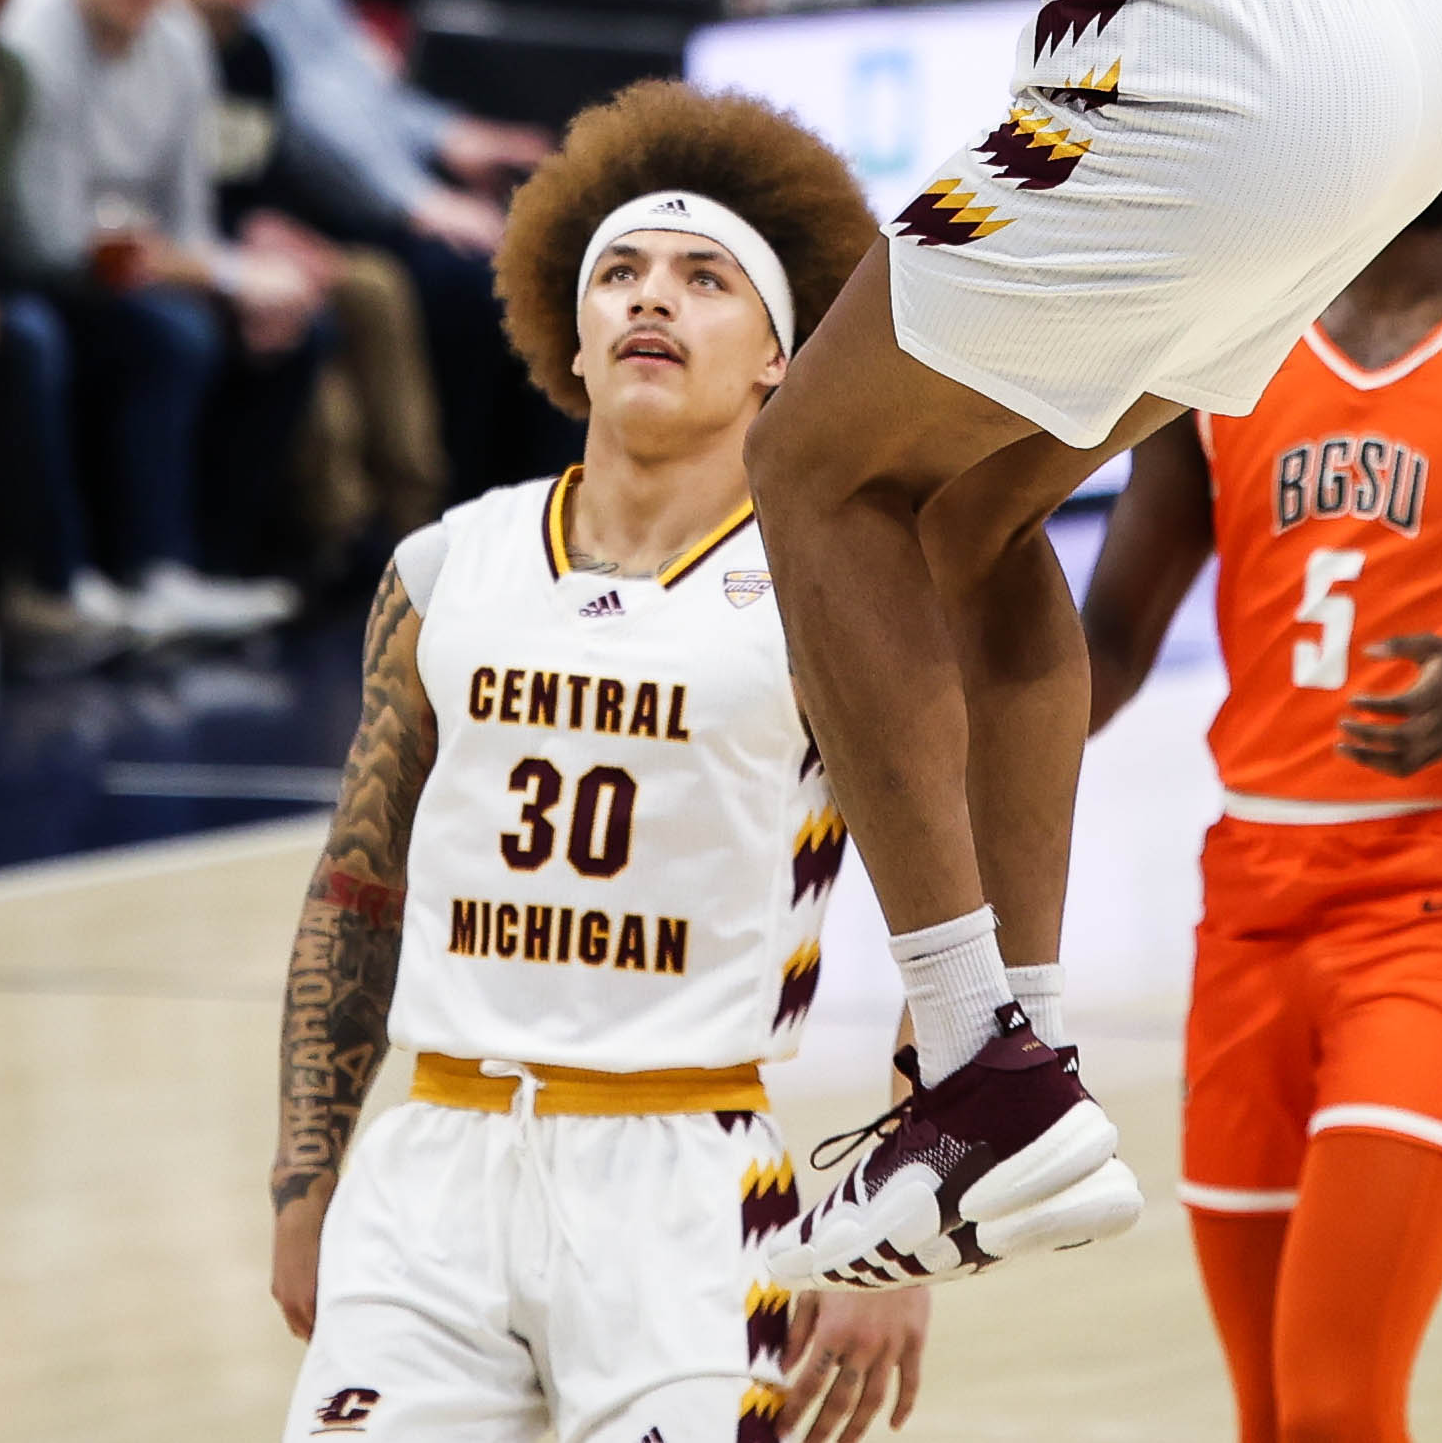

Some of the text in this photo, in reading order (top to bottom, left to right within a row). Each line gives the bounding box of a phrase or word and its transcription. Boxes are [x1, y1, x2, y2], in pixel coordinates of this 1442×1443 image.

[1272, 433, 1428, 539] BGSU
[1292, 547, 1366, 690] 5
[467, 665, 690, 742] CENTRAL
[499, 757, 637, 879] 30
[448, 898, 688, 976] MICHIGAN
